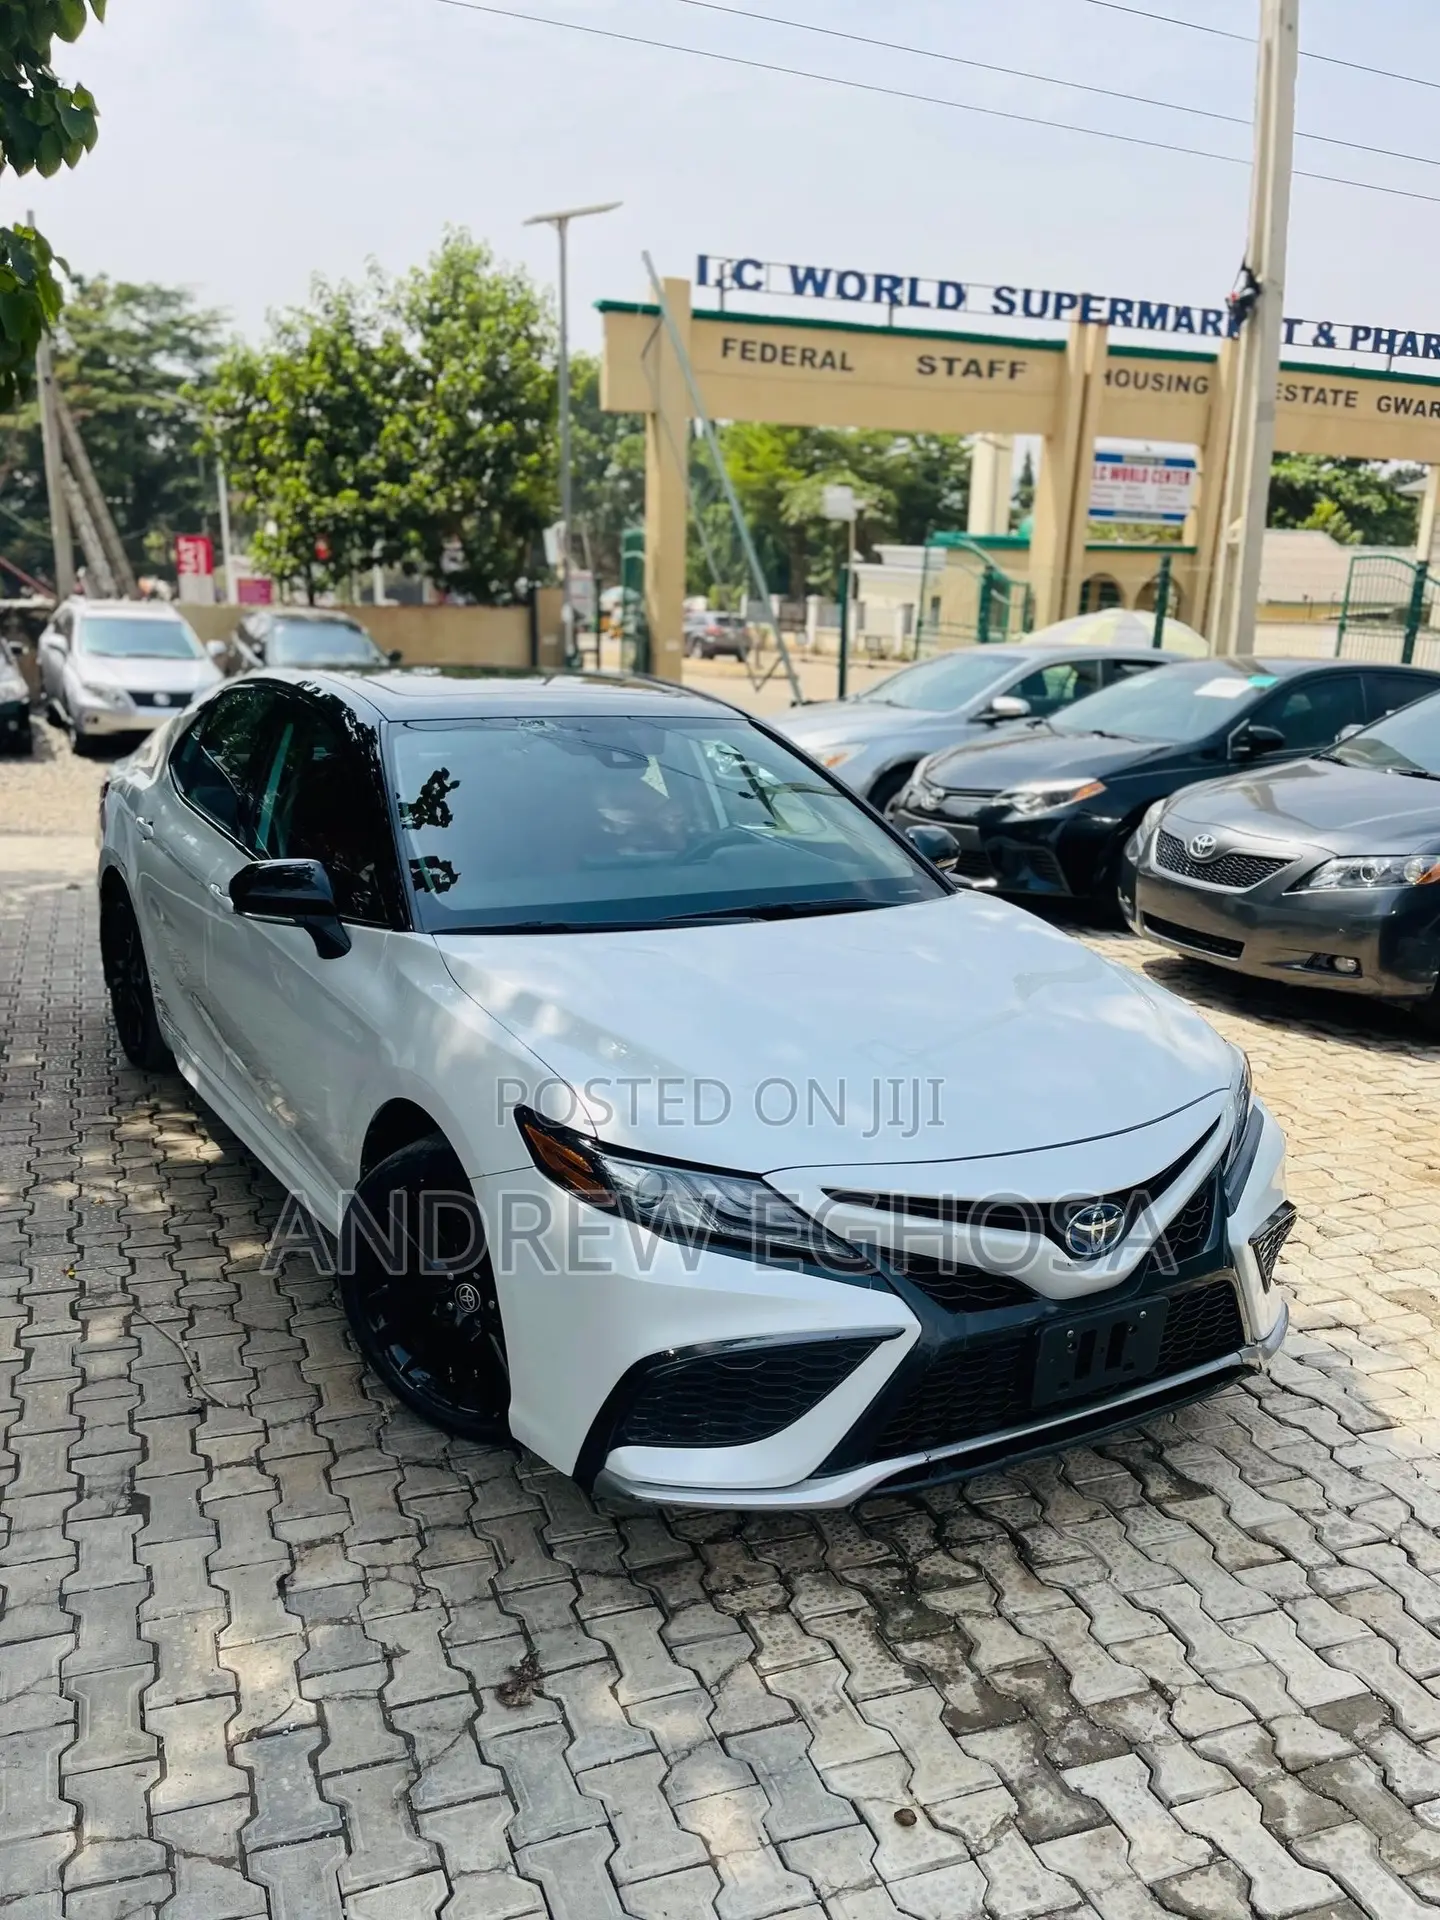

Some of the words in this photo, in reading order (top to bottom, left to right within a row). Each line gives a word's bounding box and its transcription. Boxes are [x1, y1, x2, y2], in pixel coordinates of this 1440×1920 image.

[789, 264, 968, 311] WORLD
[991, 286, 1304, 345] SUPERMART
[1312, 321, 1336, 348] &
[721, 337, 855, 372] FEDERAL
[916, 354, 1027, 380] STAFF
